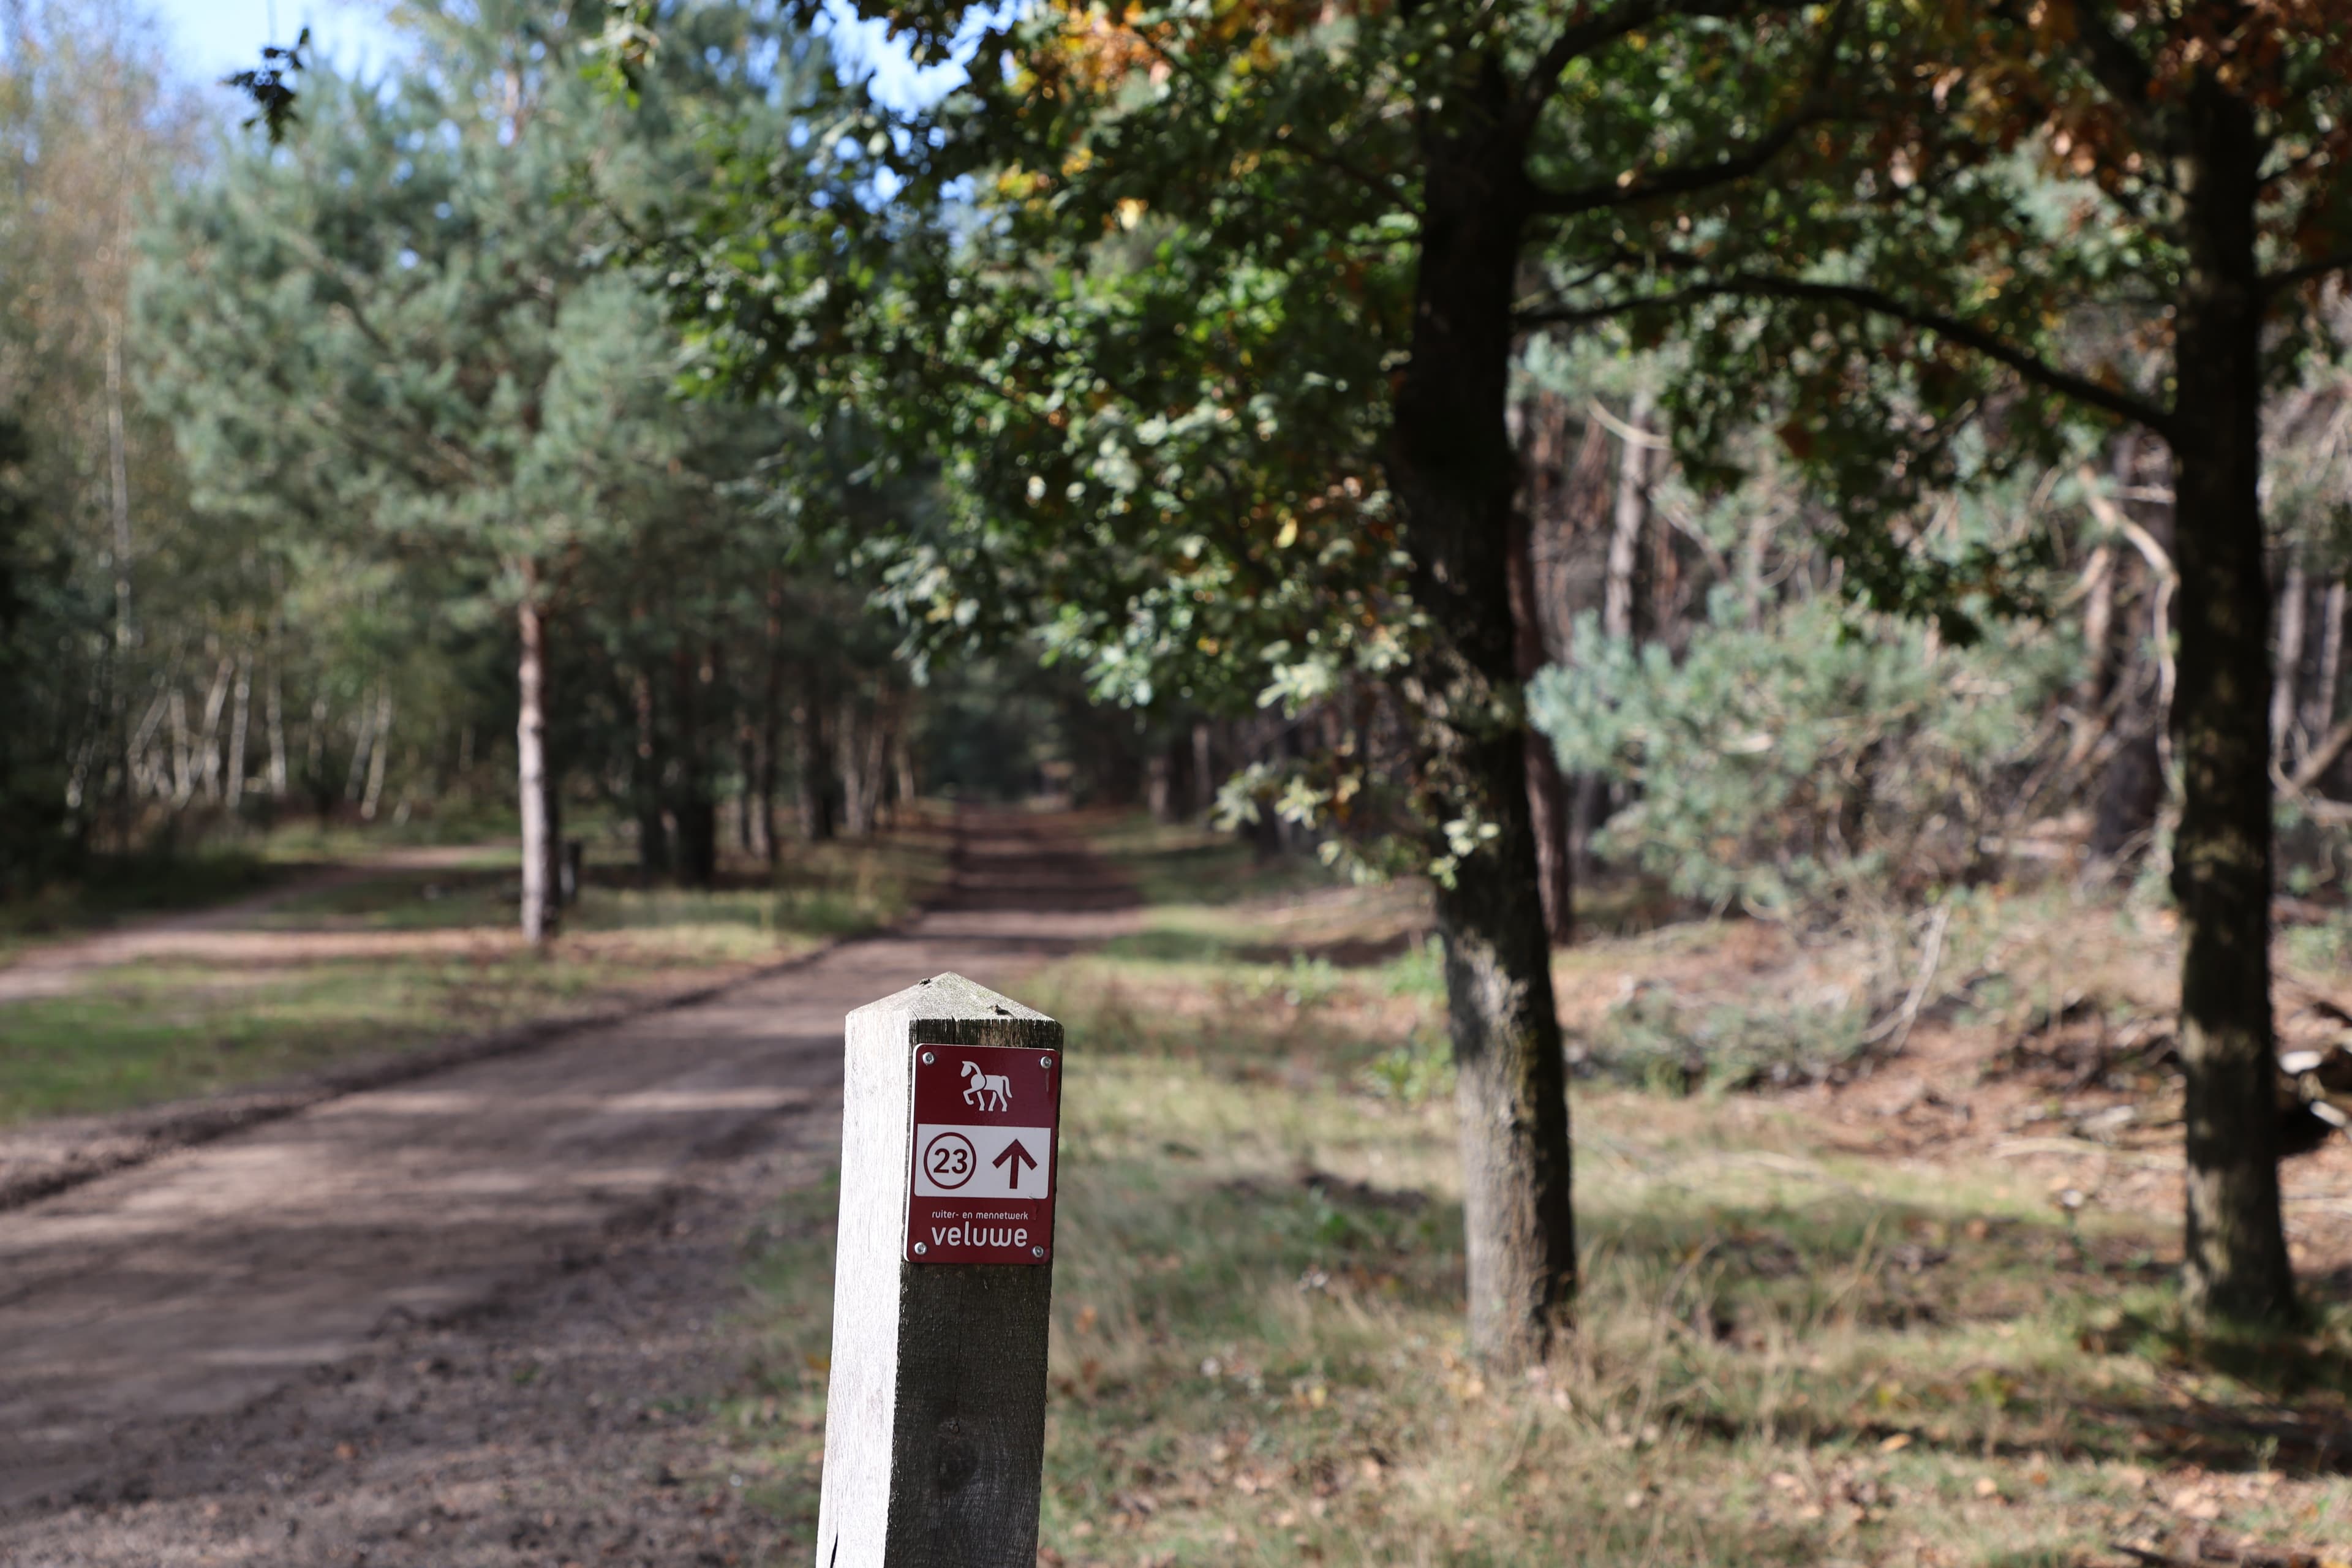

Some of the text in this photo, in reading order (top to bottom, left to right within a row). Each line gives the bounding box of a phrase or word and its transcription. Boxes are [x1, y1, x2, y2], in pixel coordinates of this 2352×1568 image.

[933, 1148, 968, 1174] 23
[932, 1210, 959, 1219] ruiter-
[976, 1211, 1028, 1220] mennetwerk
[931, 1221, 1028, 1247] veluwe
